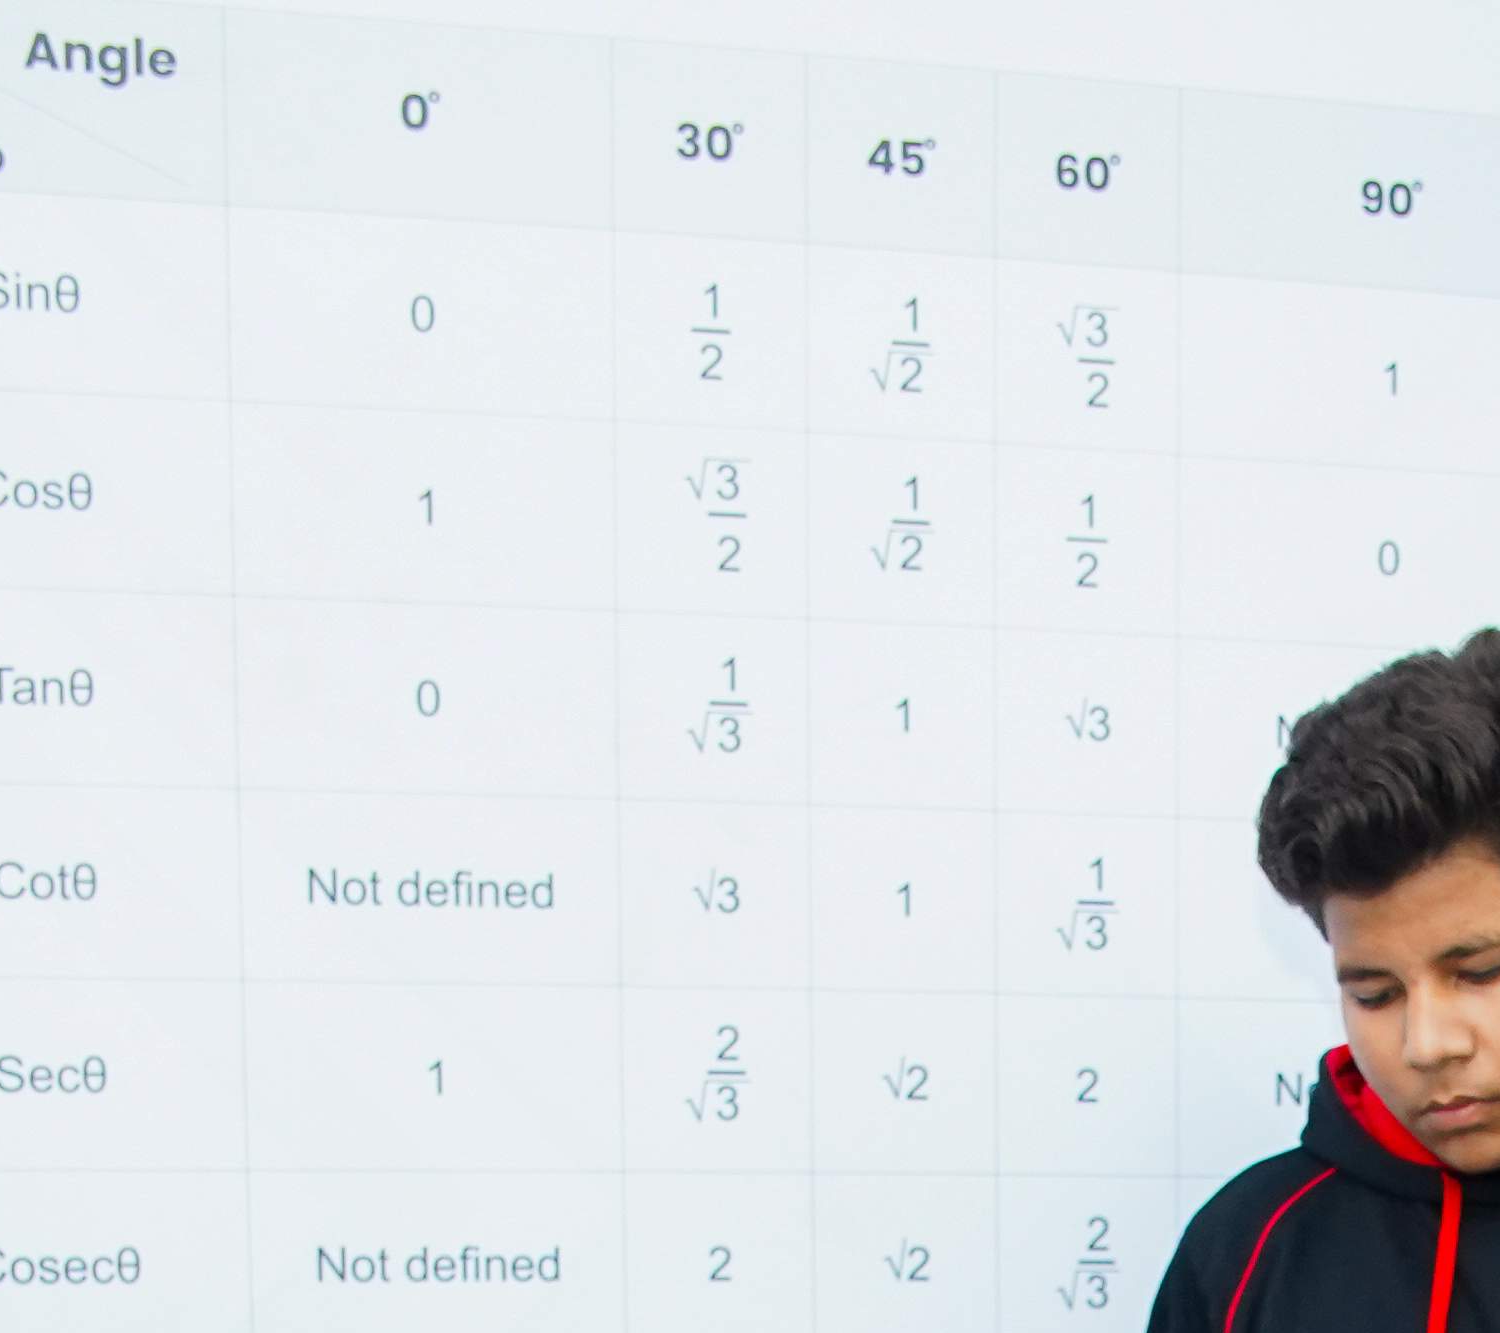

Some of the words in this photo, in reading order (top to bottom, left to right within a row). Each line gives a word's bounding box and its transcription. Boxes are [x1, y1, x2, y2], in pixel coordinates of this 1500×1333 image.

[24, 30, 178, 90] Angle
[409, 293, 437, 334] 0
[704, 282, 719, 319] 1
[904, 296, 919, 333] 1
[699, 342, 724, 382] 2
[1384, 361, 1398, 396] 1
[1086, 371, 1110, 410] 2
[418, 488, 434, 526] 1
[904, 475, 919, 511] 1
[1081, 493, 1095, 528] 1
[717, 534, 742, 574] 2
[1076, 551, 1099, 589] 2
[1376, 538, 1402, 578] 0
[722, 656, 737, 693] 1
[415, 678, 442, 719] 0
[896, 697, 910, 733] 1
[307, 867, 382, 907] Not
[396, 869, 555, 910] defined
[1089, 856, 1104, 892] 1
[896, 882, 912, 917] 1
[716, 1024, 740, 1062] 2
[428, 1059, 444, 1096] 1
[1076, 1067, 1100, 1105] 2
[1086, 1215, 1110, 1253] 2
[316, 1246, 390, 1284] Not
[404, 1244, 561, 1284] defined
[708, 1245, 733, 1283] 2
